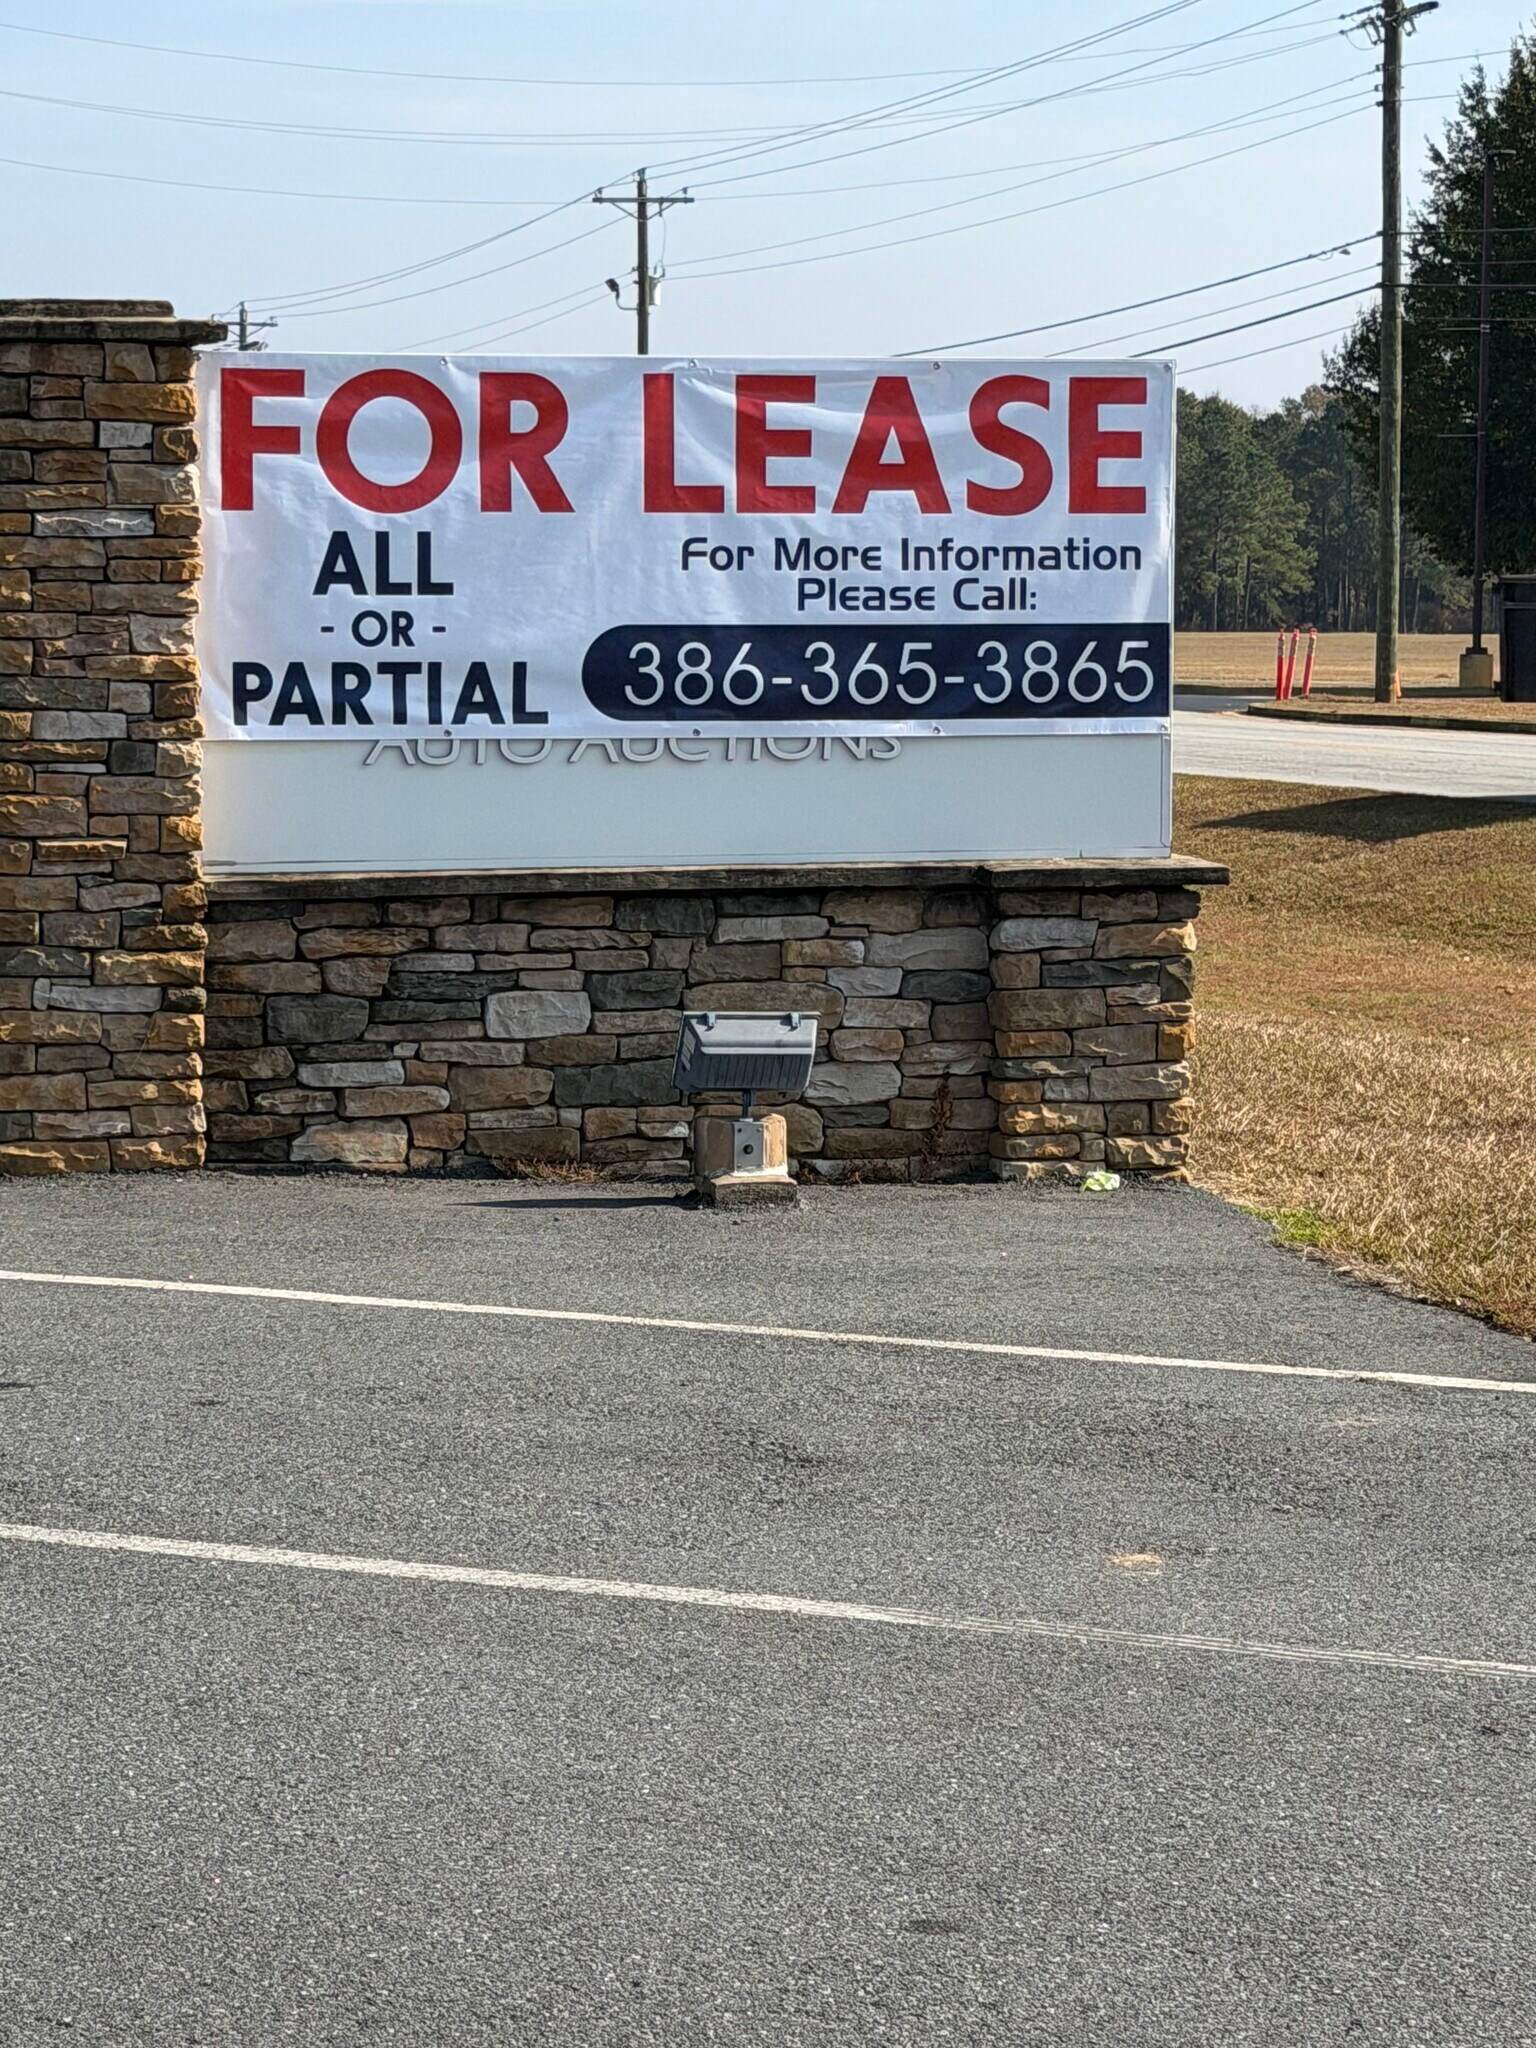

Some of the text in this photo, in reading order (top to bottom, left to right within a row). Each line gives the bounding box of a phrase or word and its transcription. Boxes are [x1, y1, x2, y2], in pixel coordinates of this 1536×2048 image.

[220, 368, 1148, 516] FOR LEASE
[312, 530, 454, 596] ALL
[681, 537, 1142, 572] For More Information
[797, 577, 1037, 612] Please Call:
[232, 661, 549, 726] PARTIAL
[624, 640, 1155, 706] 386-365-3865
